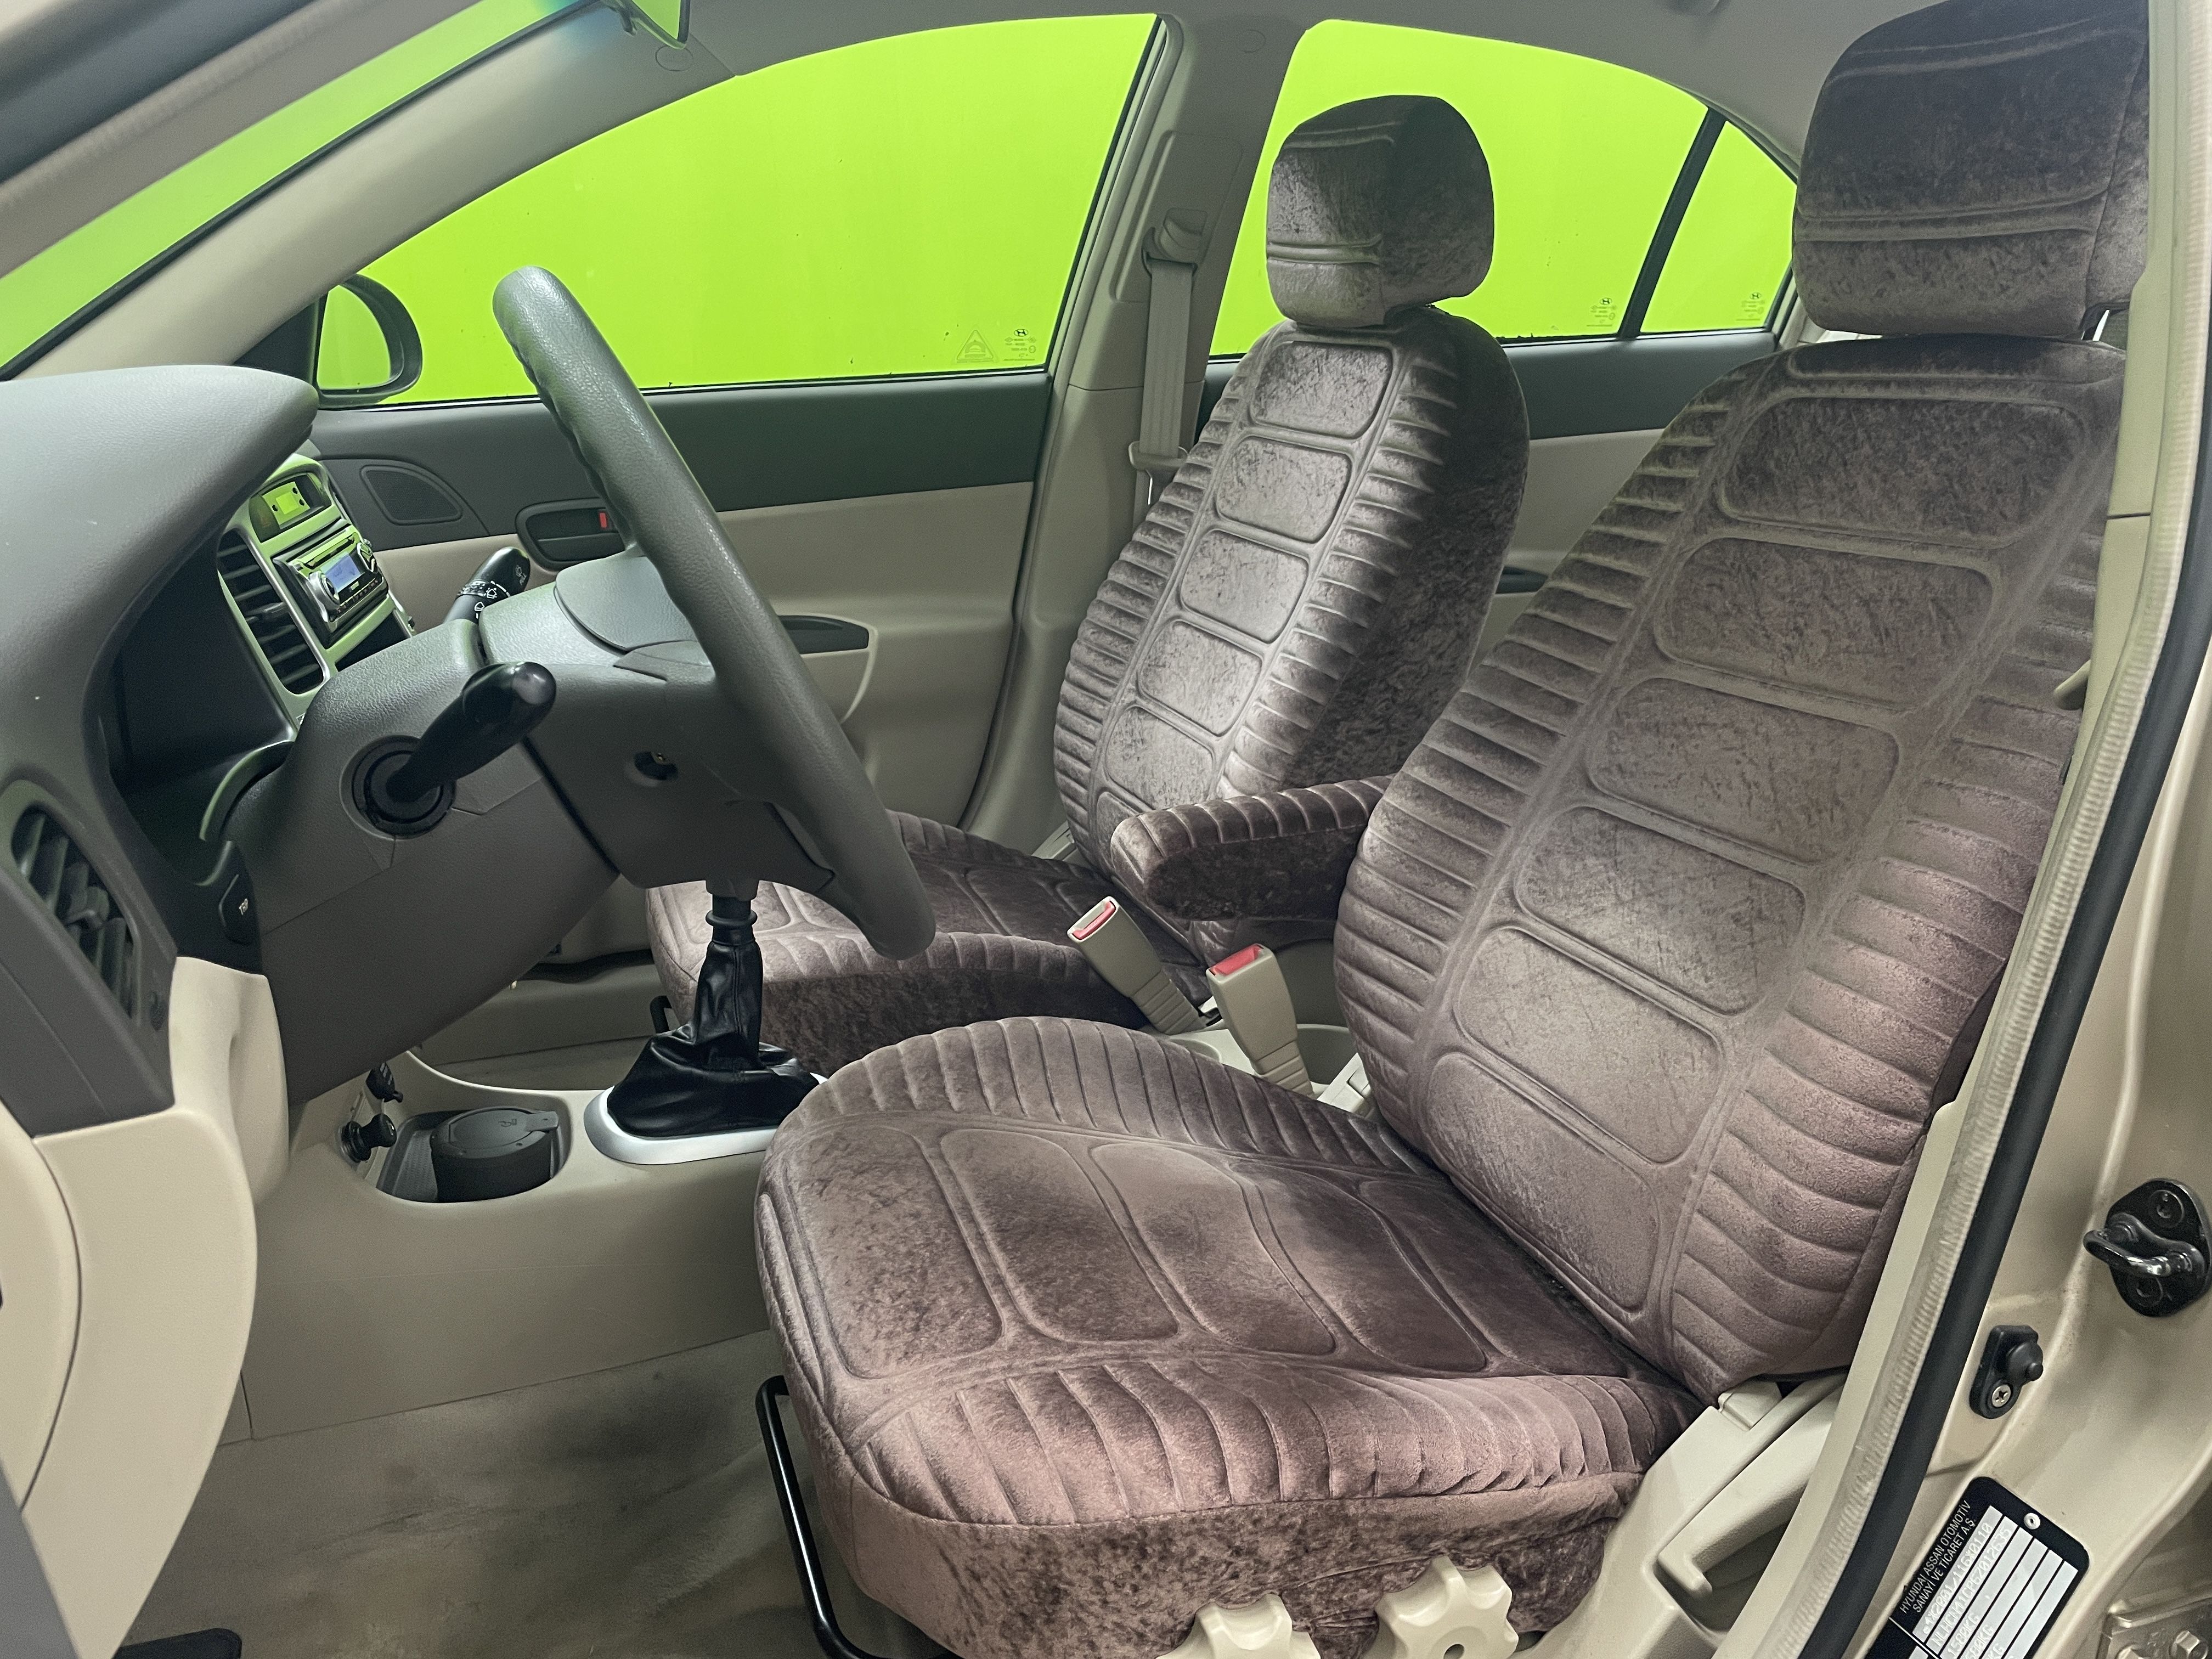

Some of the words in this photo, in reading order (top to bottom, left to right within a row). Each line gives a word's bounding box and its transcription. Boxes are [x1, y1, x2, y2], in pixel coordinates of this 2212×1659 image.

[1899, 1573, 1927, 1614] HYUNDAI
[1923, 1544, 1945, 1576] ASSAN
[1930, 1567, 1944, 1580] VE
